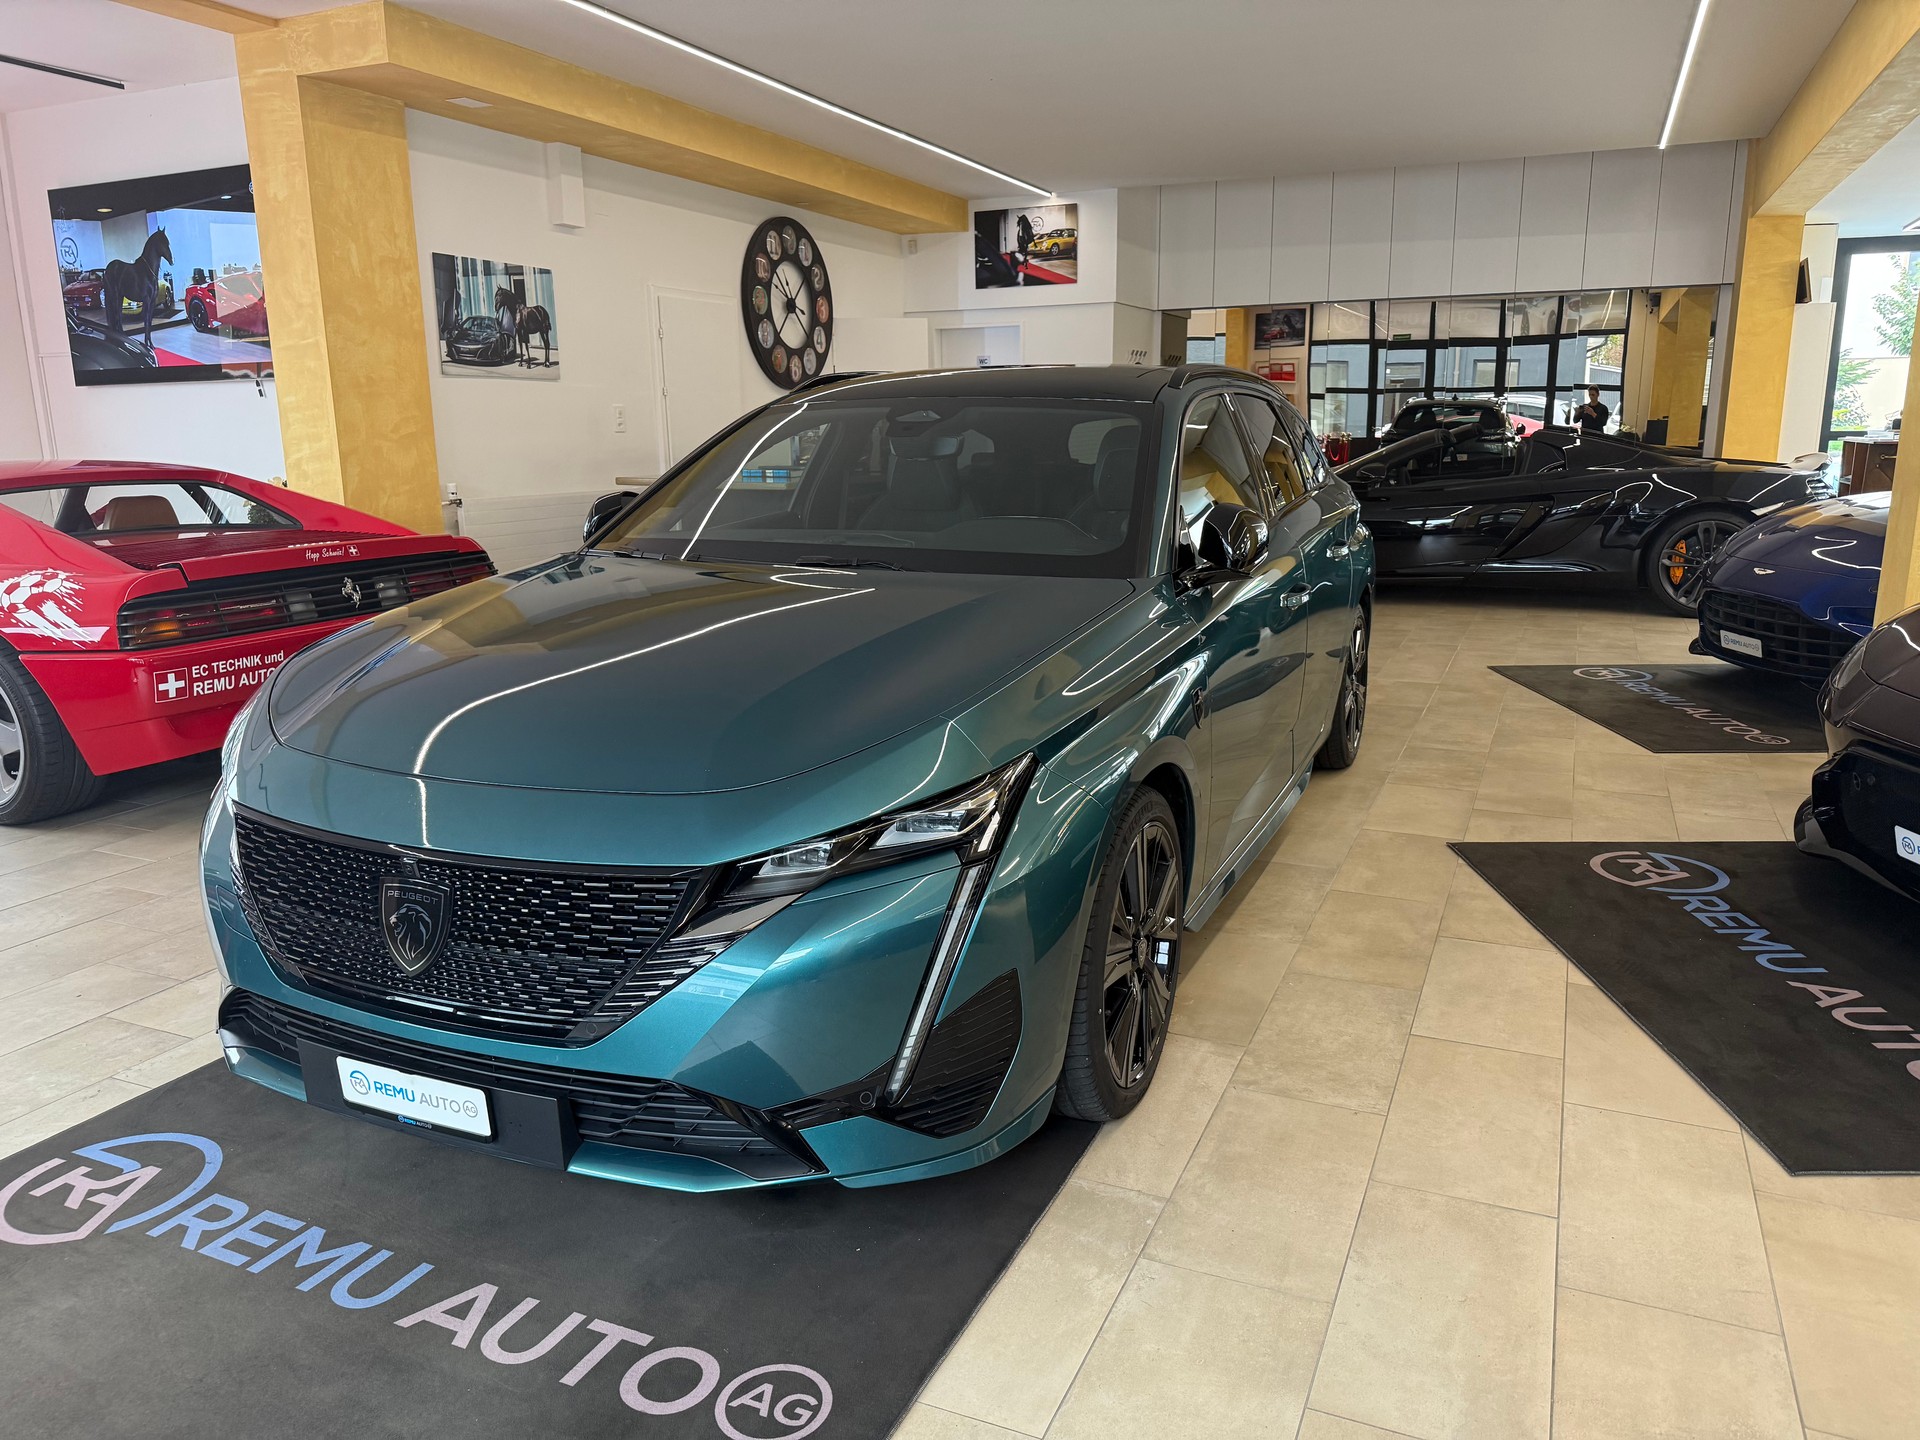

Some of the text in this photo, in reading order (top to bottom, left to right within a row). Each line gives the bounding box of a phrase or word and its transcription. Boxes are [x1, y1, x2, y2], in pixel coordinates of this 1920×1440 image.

[814, 268, 822, 289] 2
[818, 300, 826, 320] 3
[816, 329, 823, 349] 4
[792, 358, 799, 379] 6
[305, 549, 320, 562] Hopp
[192, 650, 284, 678] EC TECHNIK und
[193, 675, 235, 696] REMU
[1616, 681, 1696, 706] REMU
[1673, 706, 1761, 735] AUTO
[387, 890, 439, 905] PEUGEOT
[1667, 896, 1829, 973] REMU
[1785, 981, 1920, 1082] AUT
[373, 1080, 415, 1102] REMU
[420, 1092, 461, 1113] AUTO
[465, 1105, 477, 1114] AG
[145, 1193, 436, 1309] REMU
[393, 1282, 721, 1415] AUTO
[727, 1382, 819, 1426] AG
